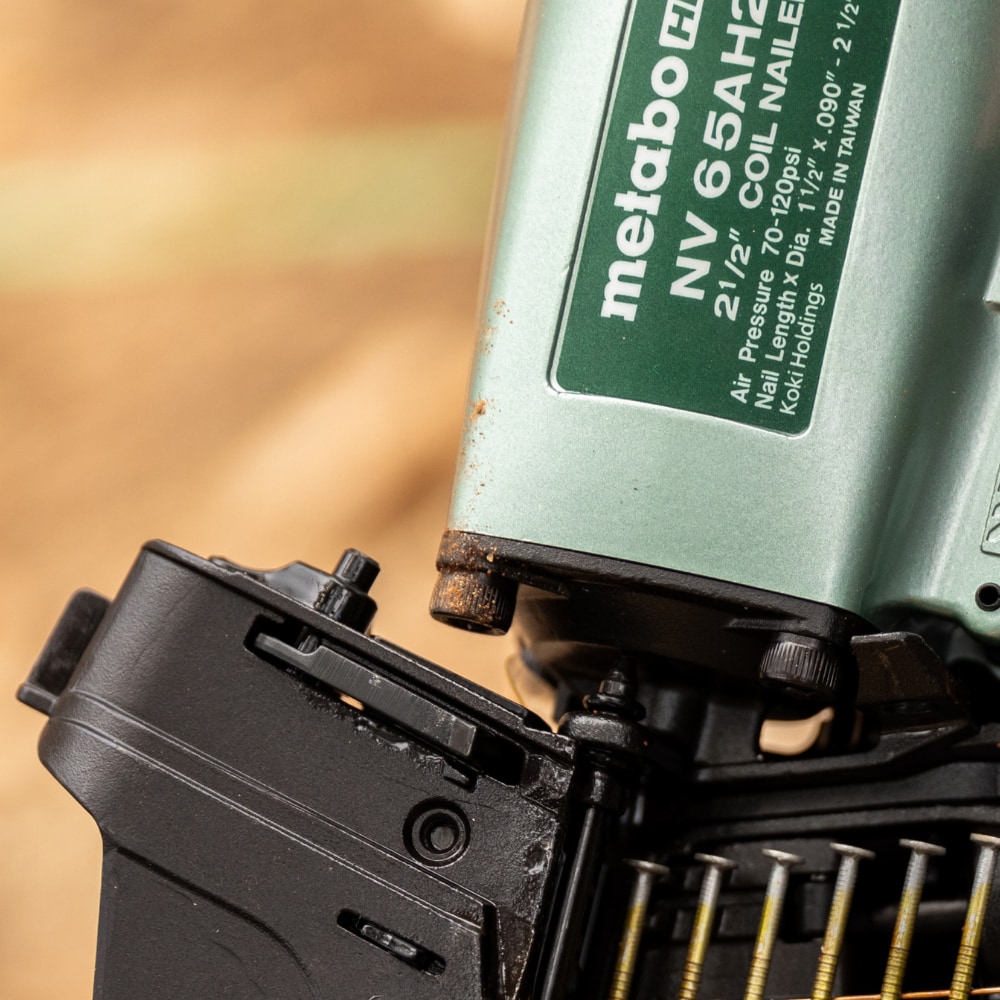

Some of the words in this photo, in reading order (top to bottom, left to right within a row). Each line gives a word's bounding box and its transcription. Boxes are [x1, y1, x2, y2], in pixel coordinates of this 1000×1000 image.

[739, 123, 777, 208] COIL
[759, 0, 805, 112] NAILE
[838, 82, 867, 157] TAIWAN
[813, 138, 828, 152] x
[832, 163, 849, 183] IN
[601, 56, 688, 321] metabo
[762, 147, 802, 256] 70-120psi
[819, 187, 844, 246] MADE
[670, 211, 717, 300] NV
[784, 272, 798, 286] x
[786, 228, 810, 266] Dia.
[739, 270, 775, 362] Pressure
[765, 291, 798, 361] Length
[790, 283, 825, 367] Holdings
[731, 373, 751, 404] Air
[755, 370, 779, 409] Nail
[780, 371, 804, 415] Koki
